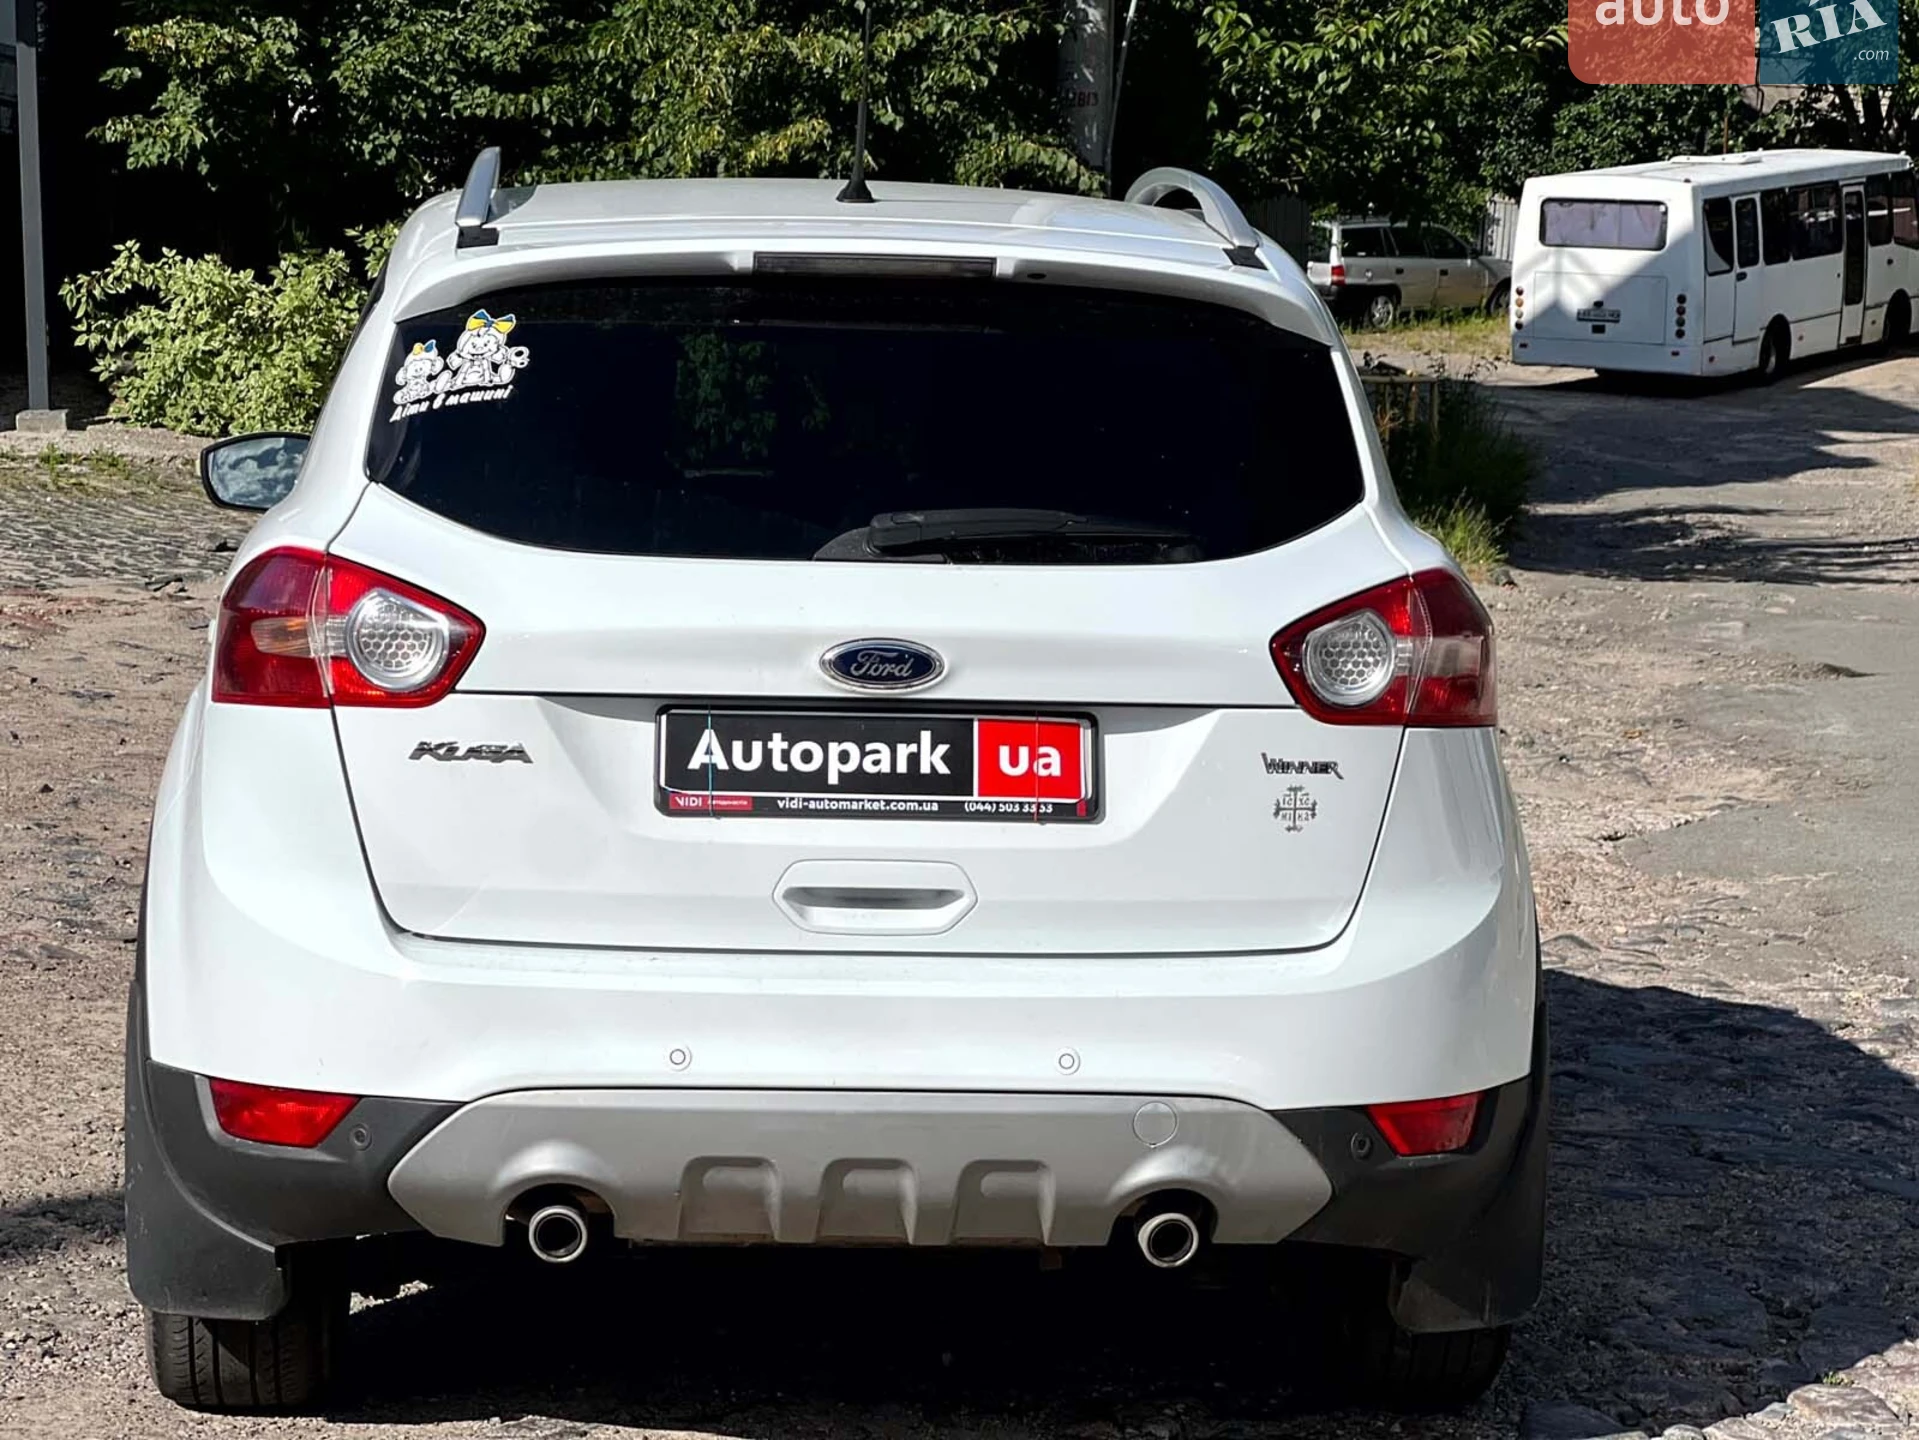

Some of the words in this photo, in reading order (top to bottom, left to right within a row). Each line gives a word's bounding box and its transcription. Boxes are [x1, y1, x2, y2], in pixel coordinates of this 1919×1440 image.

[389, 400, 430, 423] Діти
[445, 385, 514, 407] машині
[850, 650, 914, 677] Ford
[408, 741, 534, 764] KUGA
[687, 729, 951, 785] Autopark
[999, 745, 1061, 776] ua
[675, 796, 703, 807] VIDI
[777, 797, 939, 812] vidi-automarket.com.ua
[964, 801, 996, 813] (044)
